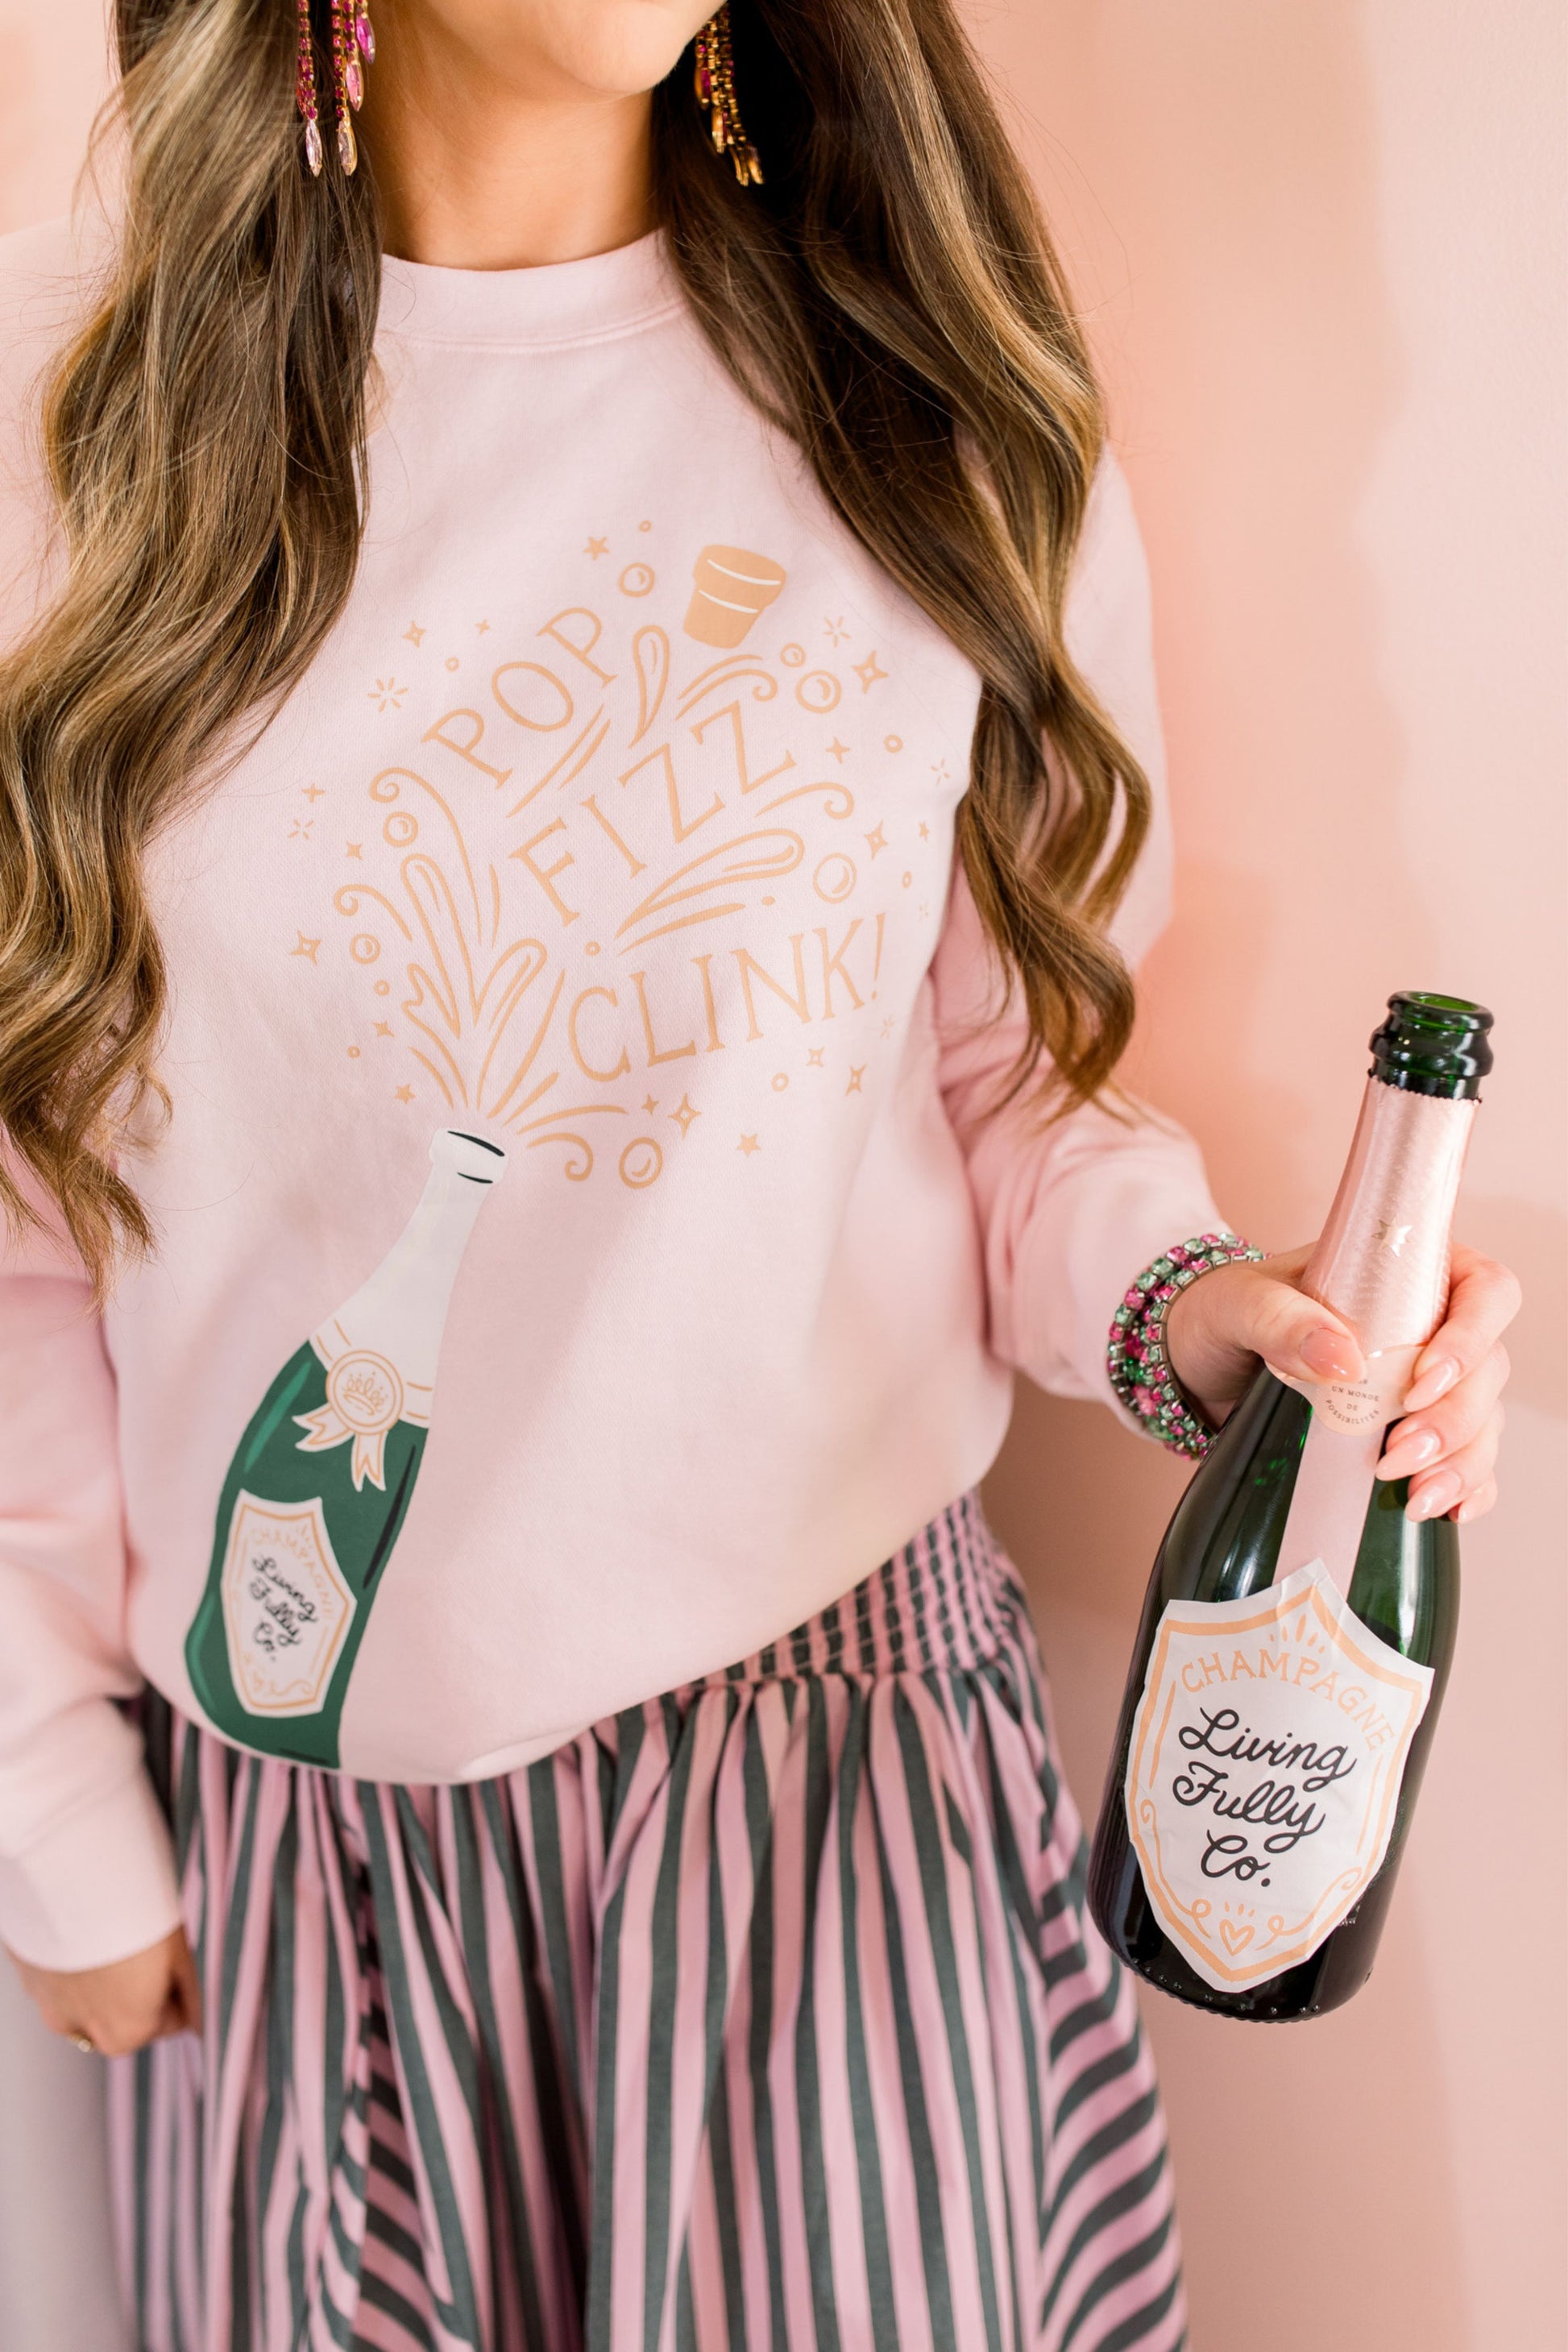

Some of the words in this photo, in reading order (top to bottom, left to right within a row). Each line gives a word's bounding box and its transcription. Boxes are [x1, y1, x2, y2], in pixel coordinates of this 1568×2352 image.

[421, 607, 617, 788] POP
[509, 701, 797, 926] FIZZ
[568, 913, 887, 1082] CLINK!
[1332, 1385, 1344, 1394] UN
[1348, 1389, 1379, 1402] MONDE
[1346, 1403, 1358, 1412] DE
[250, 1576, 302, 1647] Fully
[252, 1555, 319, 1623] Living
[253, 1619, 276, 1662] Co.
[1181, 1649, 1395, 1751] CHAMPAGNE
[1178, 1707, 1358, 1793] Living
[1172, 1761, 1326, 1853] Fully
[1201, 1829, 1271, 1887] Co.
